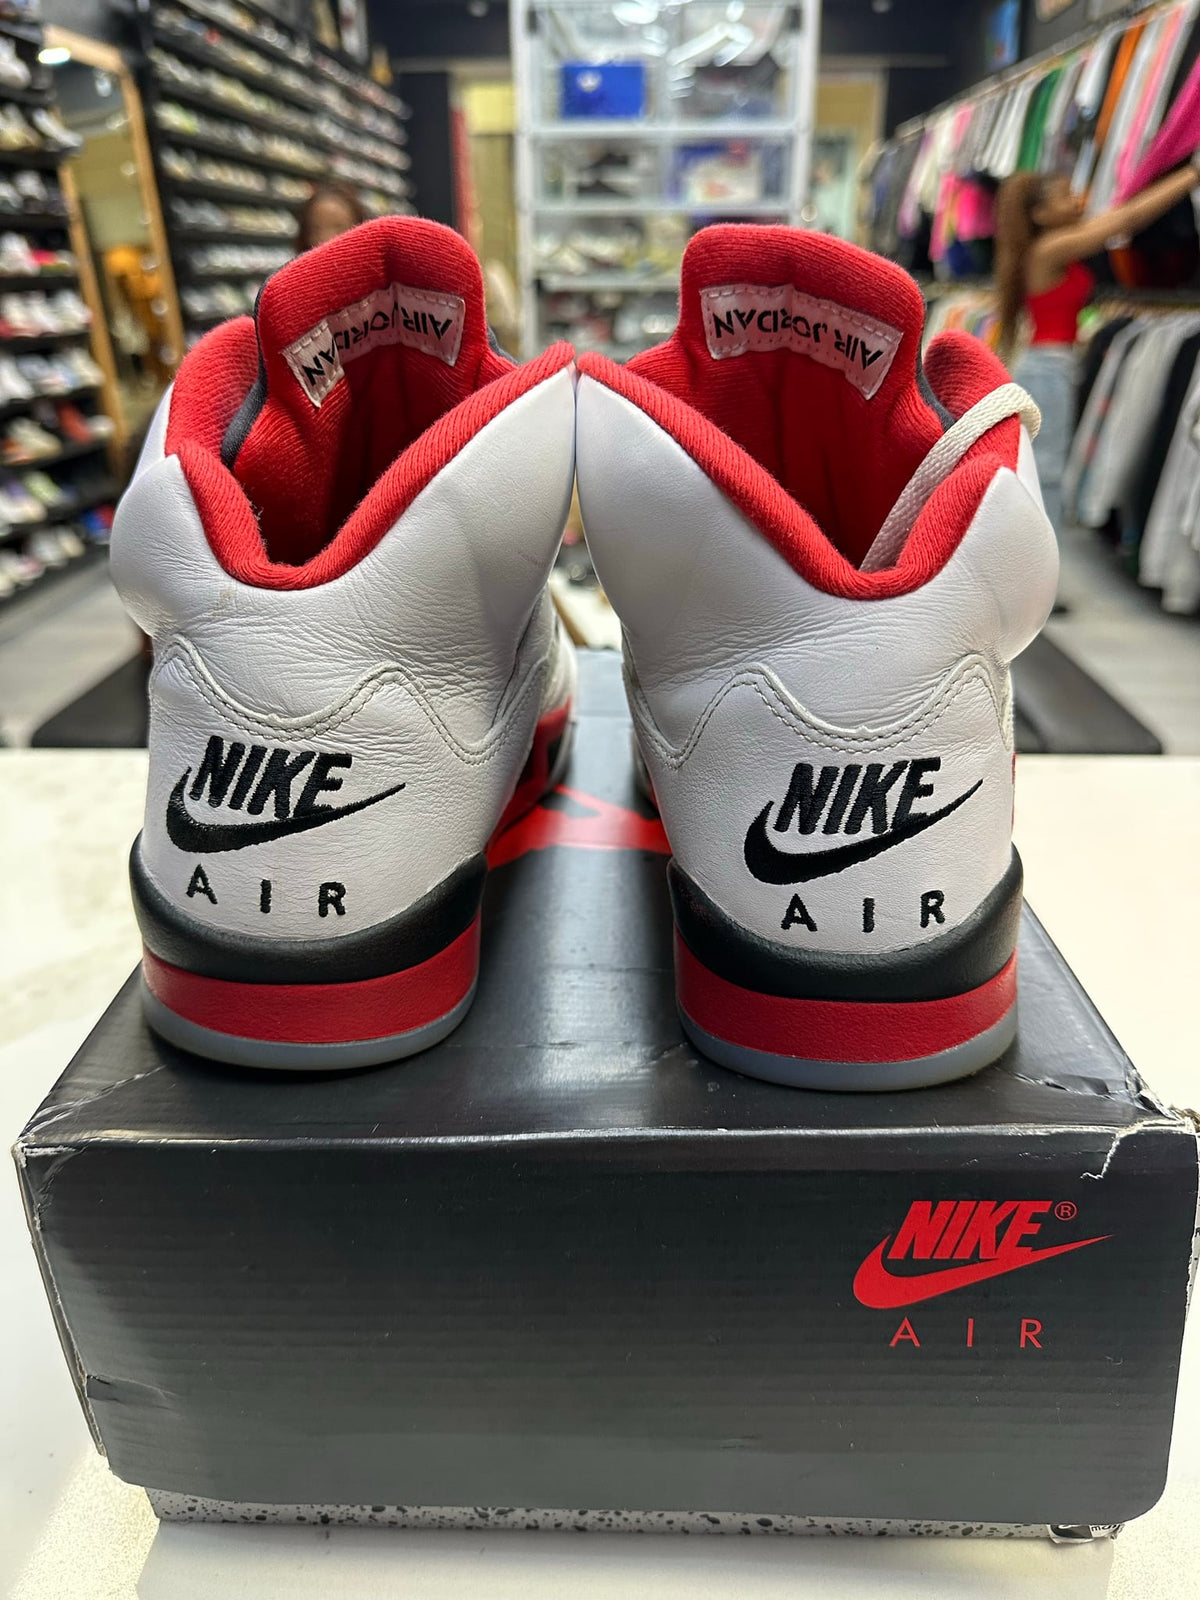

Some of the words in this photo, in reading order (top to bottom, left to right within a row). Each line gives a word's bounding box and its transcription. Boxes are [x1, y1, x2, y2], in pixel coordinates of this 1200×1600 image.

[401, 307, 452, 341] AIR
[713, 308, 828, 343] JORDAN
[834, 329, 884, 370] AIR
[189, 735, 352, 820] NIKE
[773, 756, 941, 835] NIKE
[186, 863, 347, 918] AIR
[780, 889, 946, 933] AIR
[889, 1316, 1043, 1349] AIR
